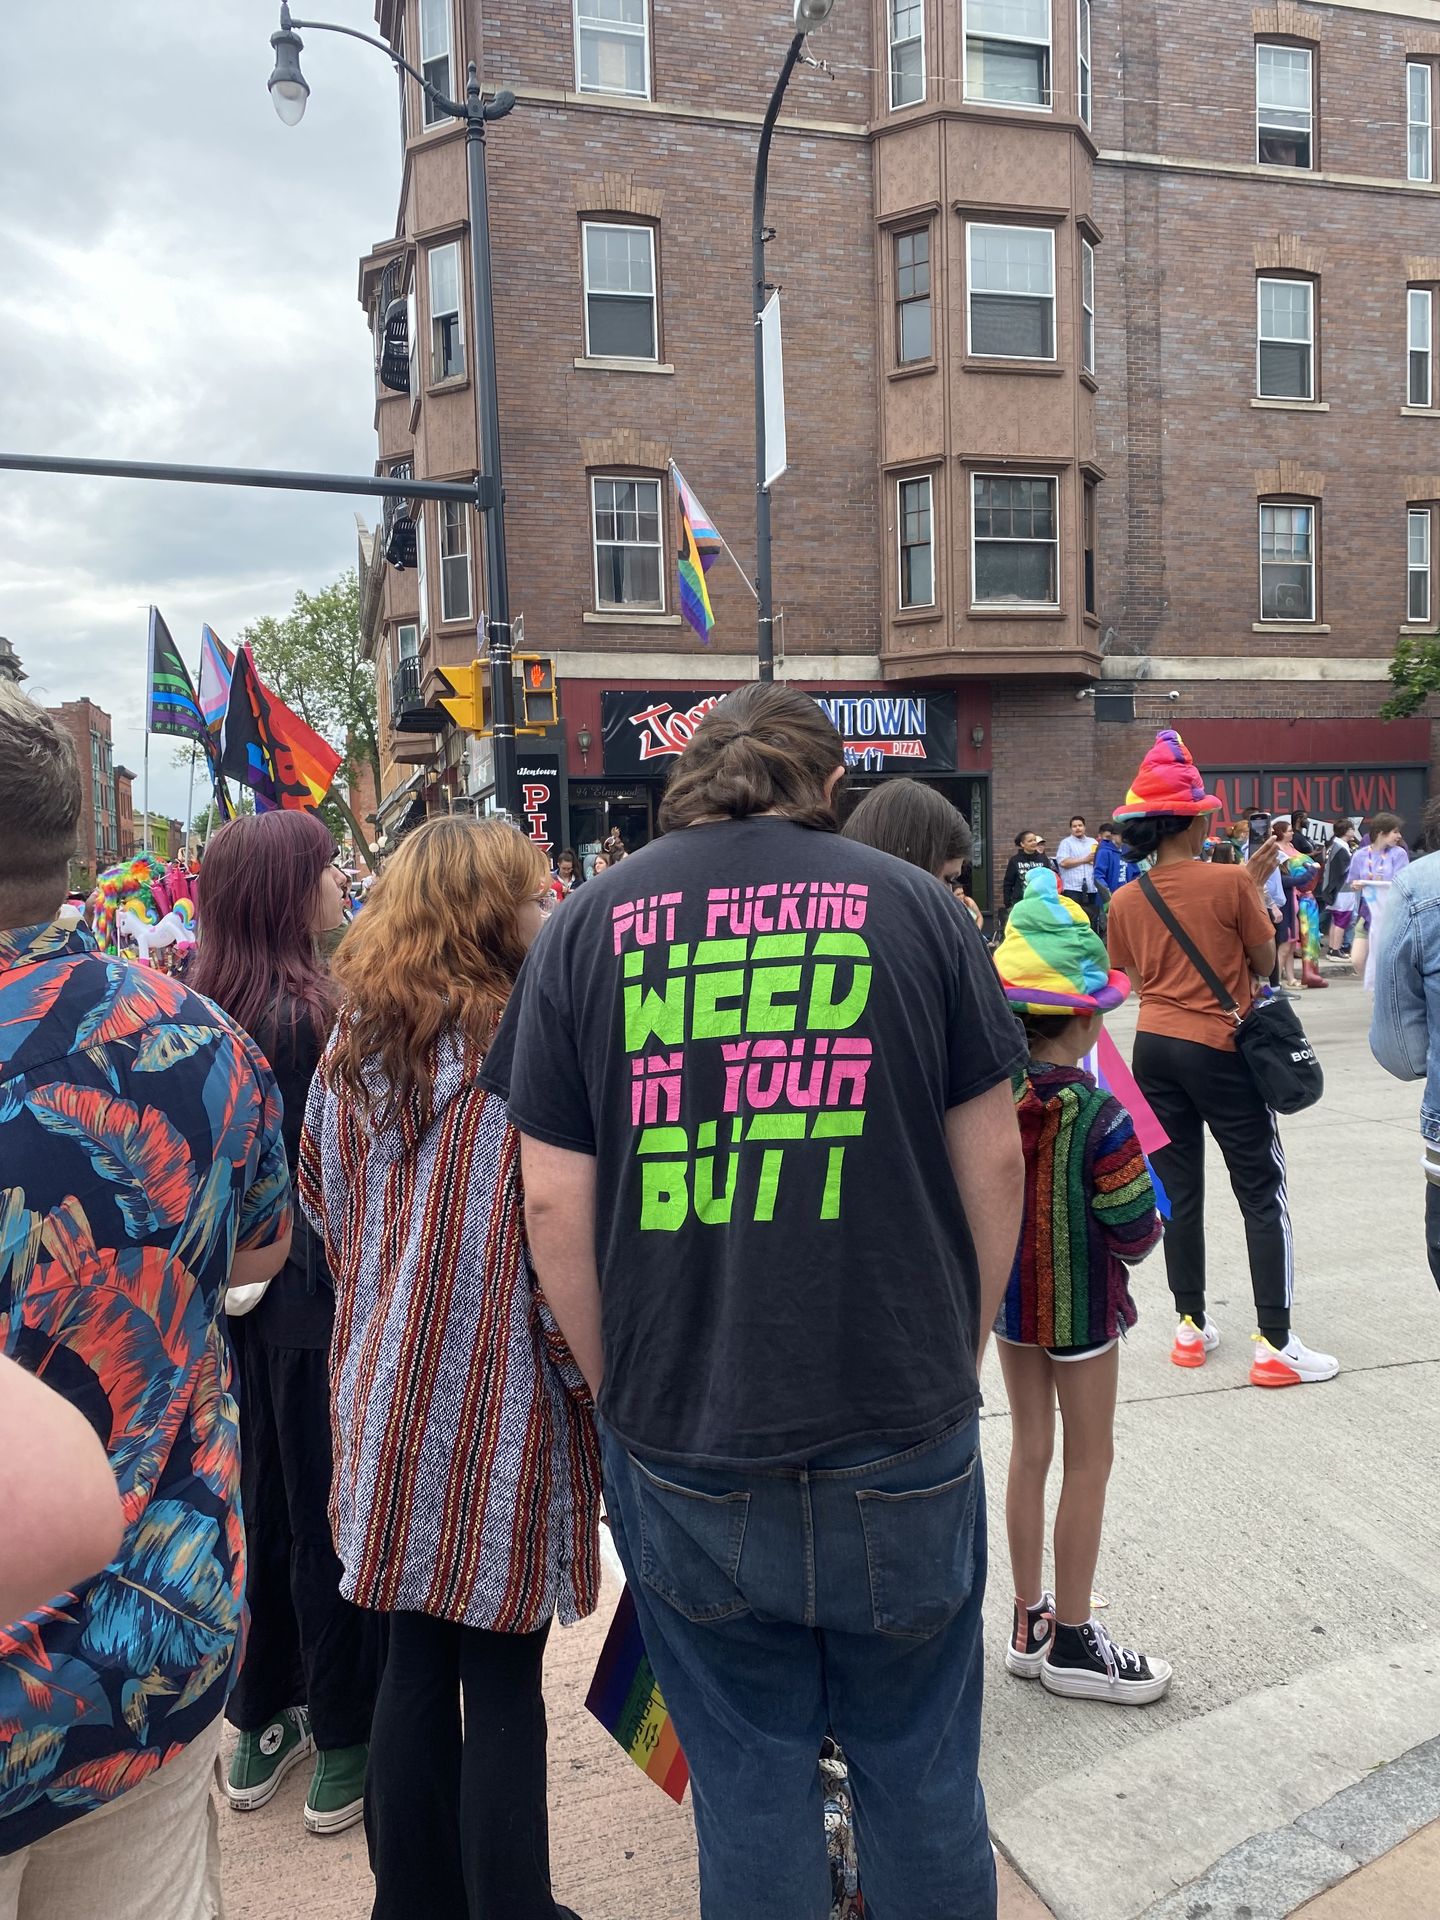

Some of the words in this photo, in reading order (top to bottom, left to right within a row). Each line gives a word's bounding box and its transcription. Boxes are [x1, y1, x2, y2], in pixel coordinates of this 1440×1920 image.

[817, 698, 927, 735] NTOWN
[892, 741, 921, 756] PIZZA
[523, 783, 554, 869] PI
[590, 783, 640, 797] Elmwood
[1208, 775, 1397, 837] ALLENTOWN
[612, 891, 683, 956] PUT
[706, 882, 869, 937] FUCKING
[623, 932, 873, 1053] WEED
[631, 1052, 684, 1126] IN
[720, 1037, 873, 1113] YOUR
[637, 1110, 867, 1232] BUTT
